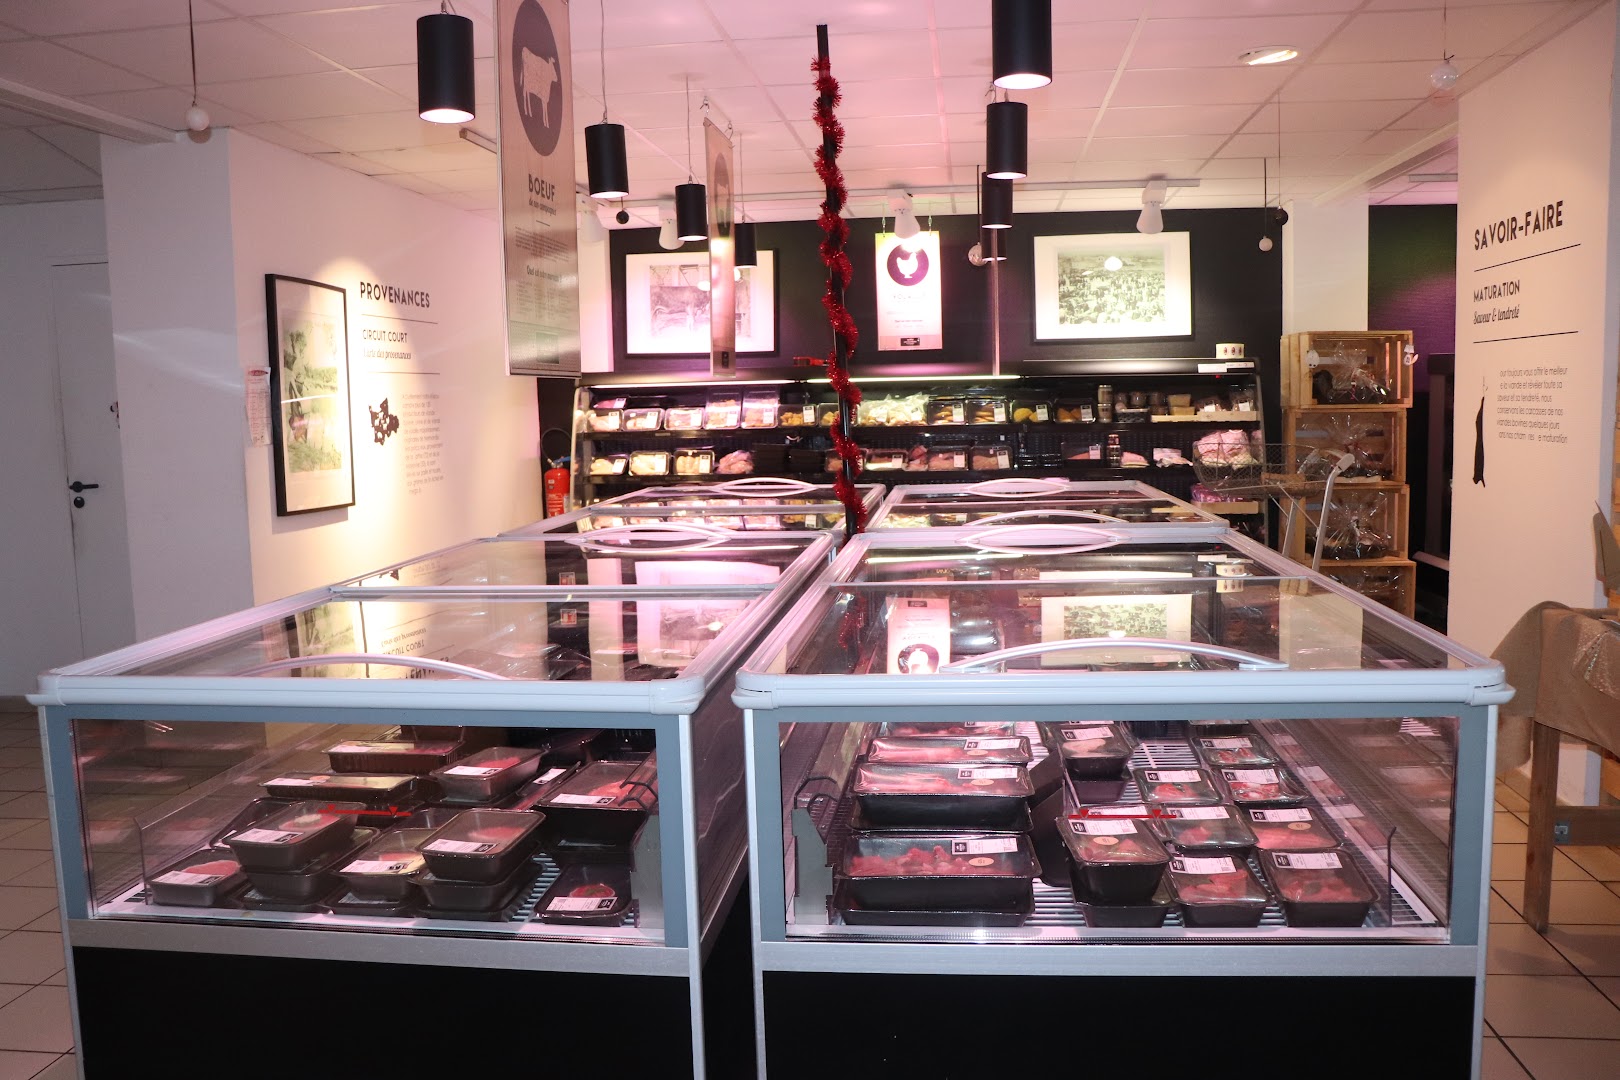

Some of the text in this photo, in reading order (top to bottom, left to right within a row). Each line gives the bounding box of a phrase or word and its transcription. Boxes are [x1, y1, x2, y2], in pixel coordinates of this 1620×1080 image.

[528, 173, 556, 201] BOEUF
[1474, 200, 1563, 251] SAVOIR-FAIRE
[360, 281, 430, 308] PROVENANCES
[1473, 279, 1520, 302] MATURATION
[1473, 311, 1491, 325] Saveur
[1498, 304, 1520, 321] tendreté
[363, 329, 408, 343] CIRCUIT COURT
